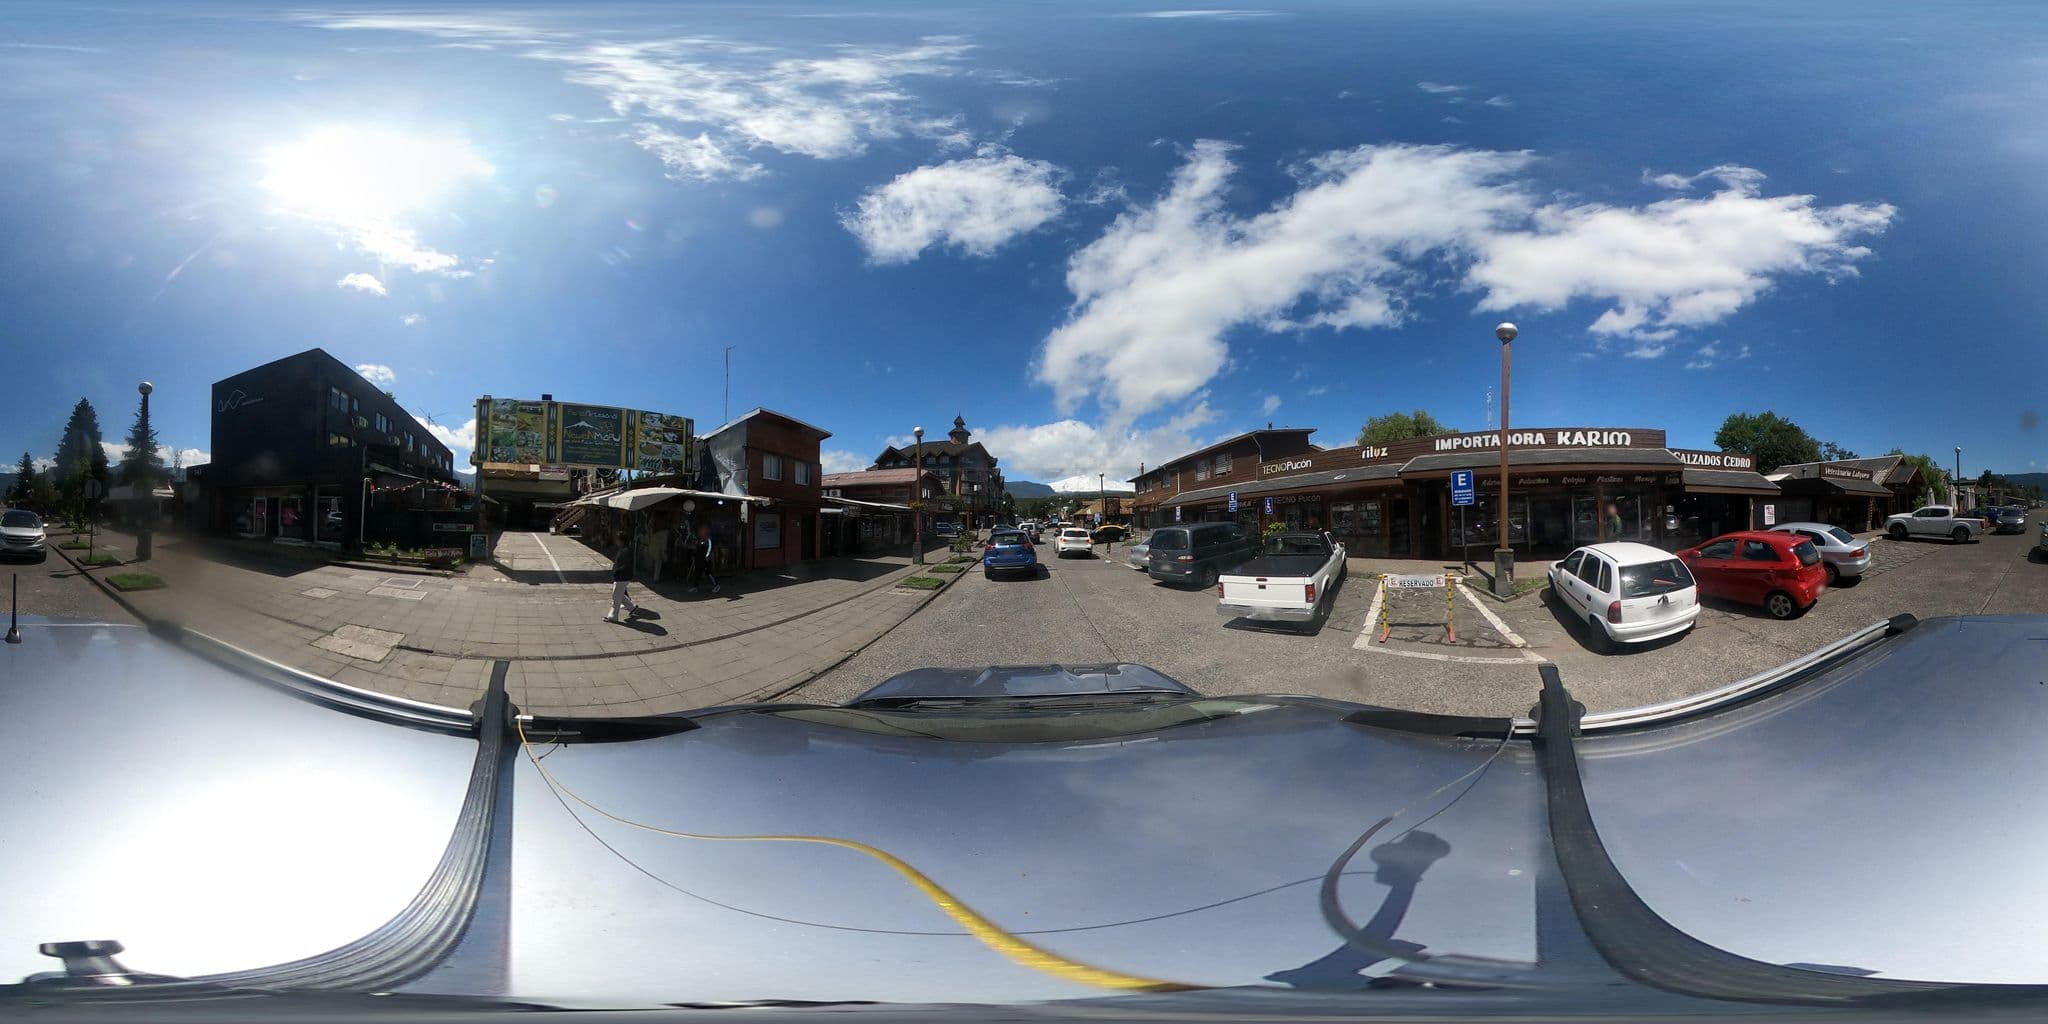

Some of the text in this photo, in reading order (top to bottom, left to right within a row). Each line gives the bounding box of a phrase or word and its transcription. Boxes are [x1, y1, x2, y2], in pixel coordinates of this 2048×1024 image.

[1435, 430, 1632, 451] IMPORTAORA KARIM
[1362, 446, 1388, 459] riluz
[1723, 455, 1751, 468] CEDRO
[1458, 473, 1467, 486] E
